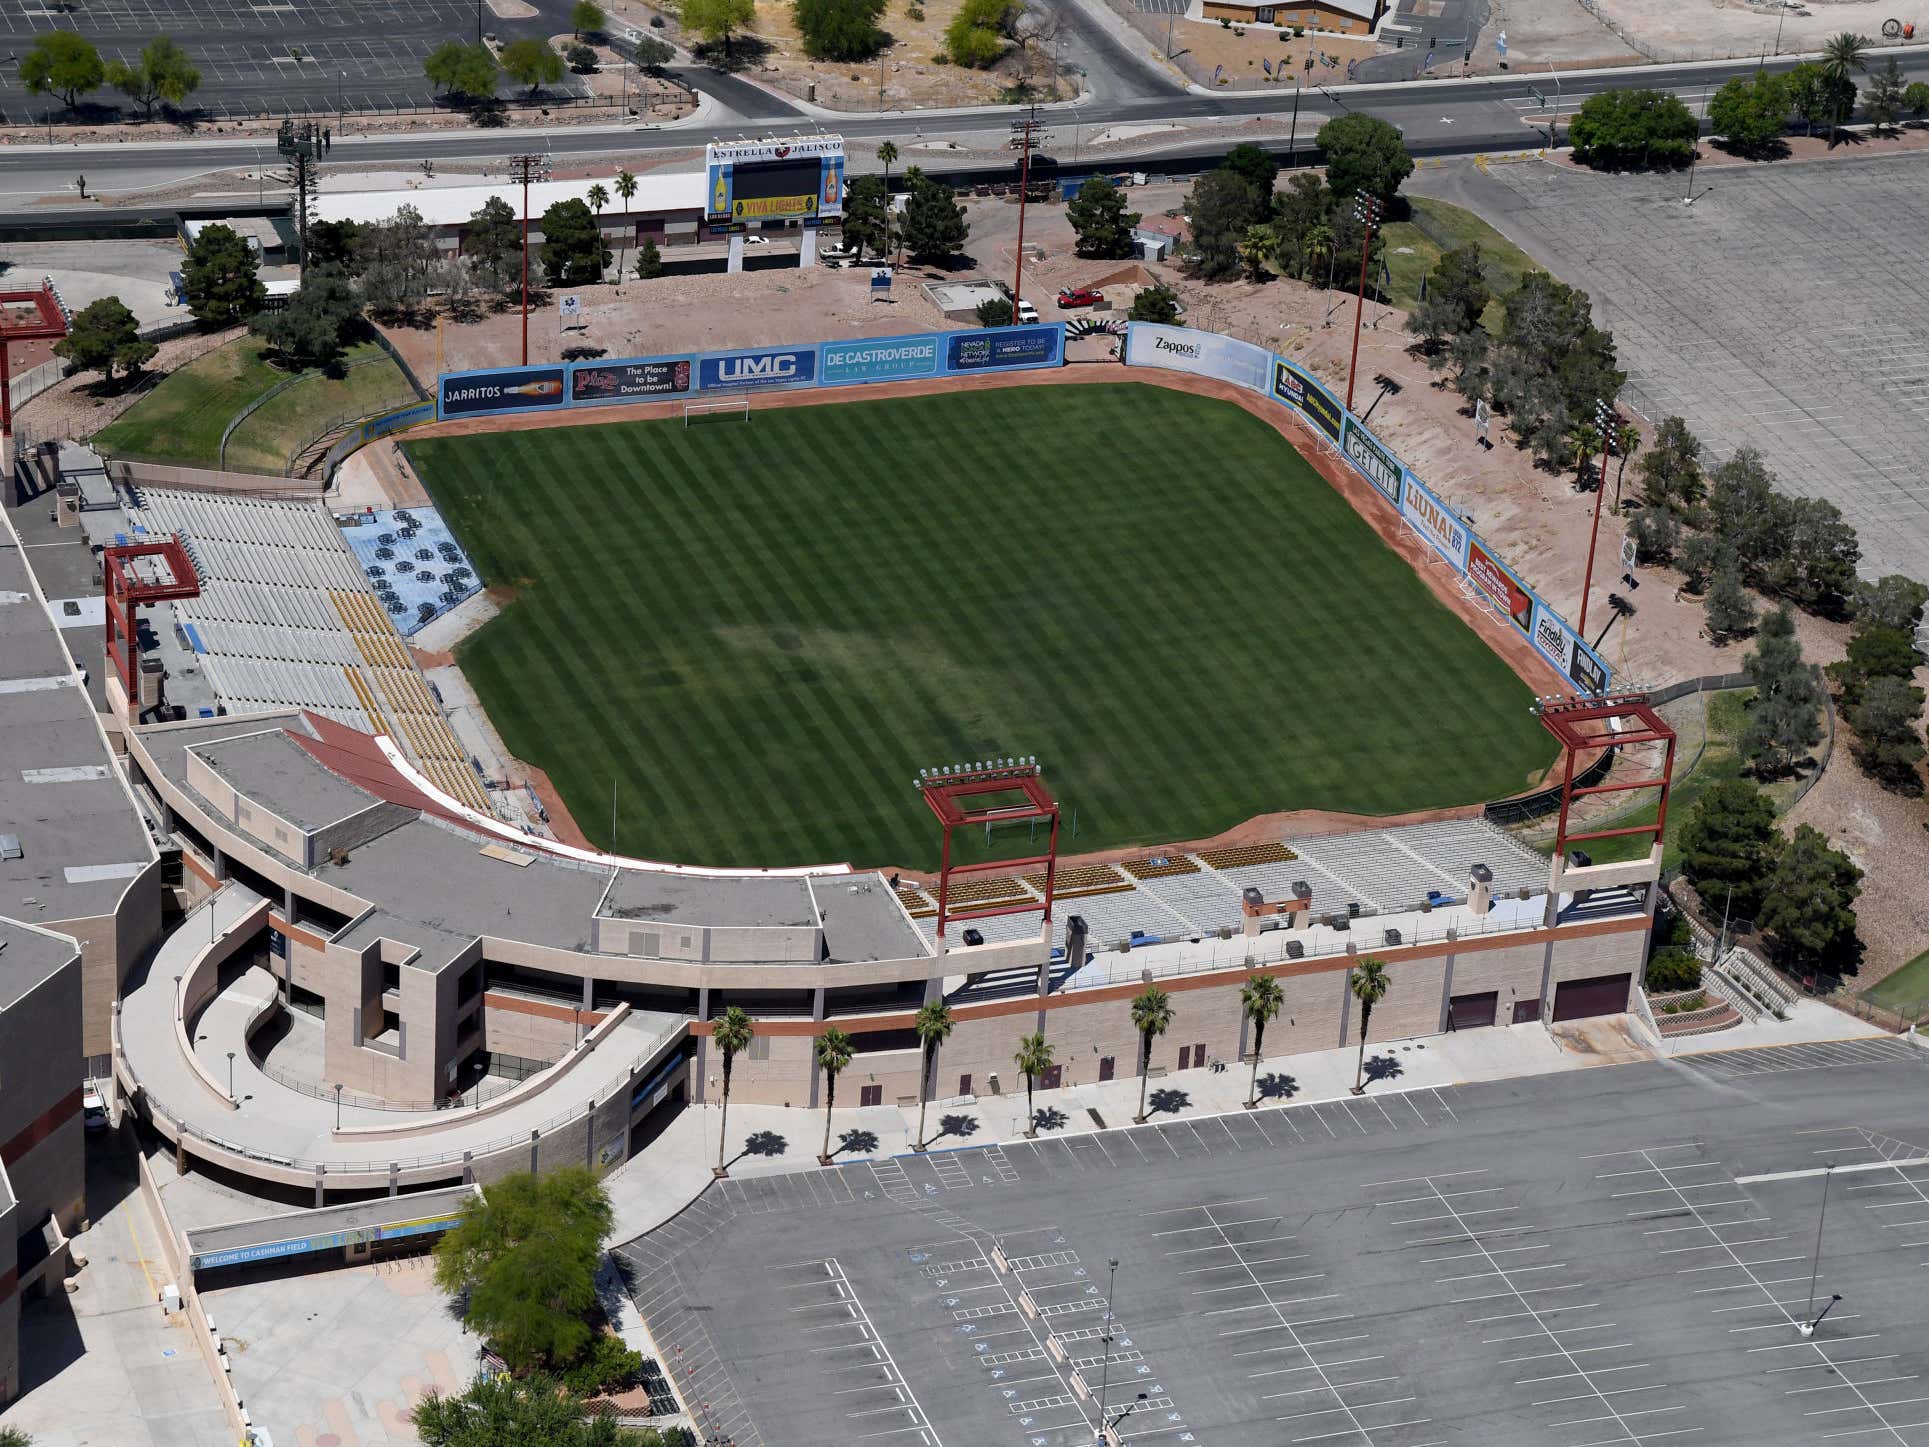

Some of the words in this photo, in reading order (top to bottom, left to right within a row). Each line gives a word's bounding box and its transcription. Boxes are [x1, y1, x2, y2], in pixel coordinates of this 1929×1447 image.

[714, 147, 772, 159] ESTRELLA
[792, 142, 840, 153] JALISCO
[746, 201, 768, 215] VIVA
[1155, 336, 1194, 354] Zappos
[827, 353, 844, 366] DE
[846, 345, 934, 364] CASTROVERDE
[626, 366, 643, 375] The
[644, 365, 668, 375] Place
[718, 355, 796, 382] UMC
[620, 382, 672, 394] Downtown!
[635, 375, 646, 384] to
[647, 374, 658, 383] be
[445, 385, 500, 403] JARRITOS
[1278, 383, 1304, 403] HYUNDAI
[1352, 441, 1375, 472] GET
[1375, 461, 1393, 490] LIT
[1406, 482, 1454, 544] LiUNA!
[1538, 618, 1566, 652] Findlay
[1536, 632, 1562, 660] TOYOTA
[1577, 649, 1602, 685] FINDLAY
[203, 1253, 239, 1266] WELCOME
[240, 1251, 250, 1260] TO
[250, 1244, 287, 1258] CASHMAN
[287, 1242, 307, 1252] FIELD
